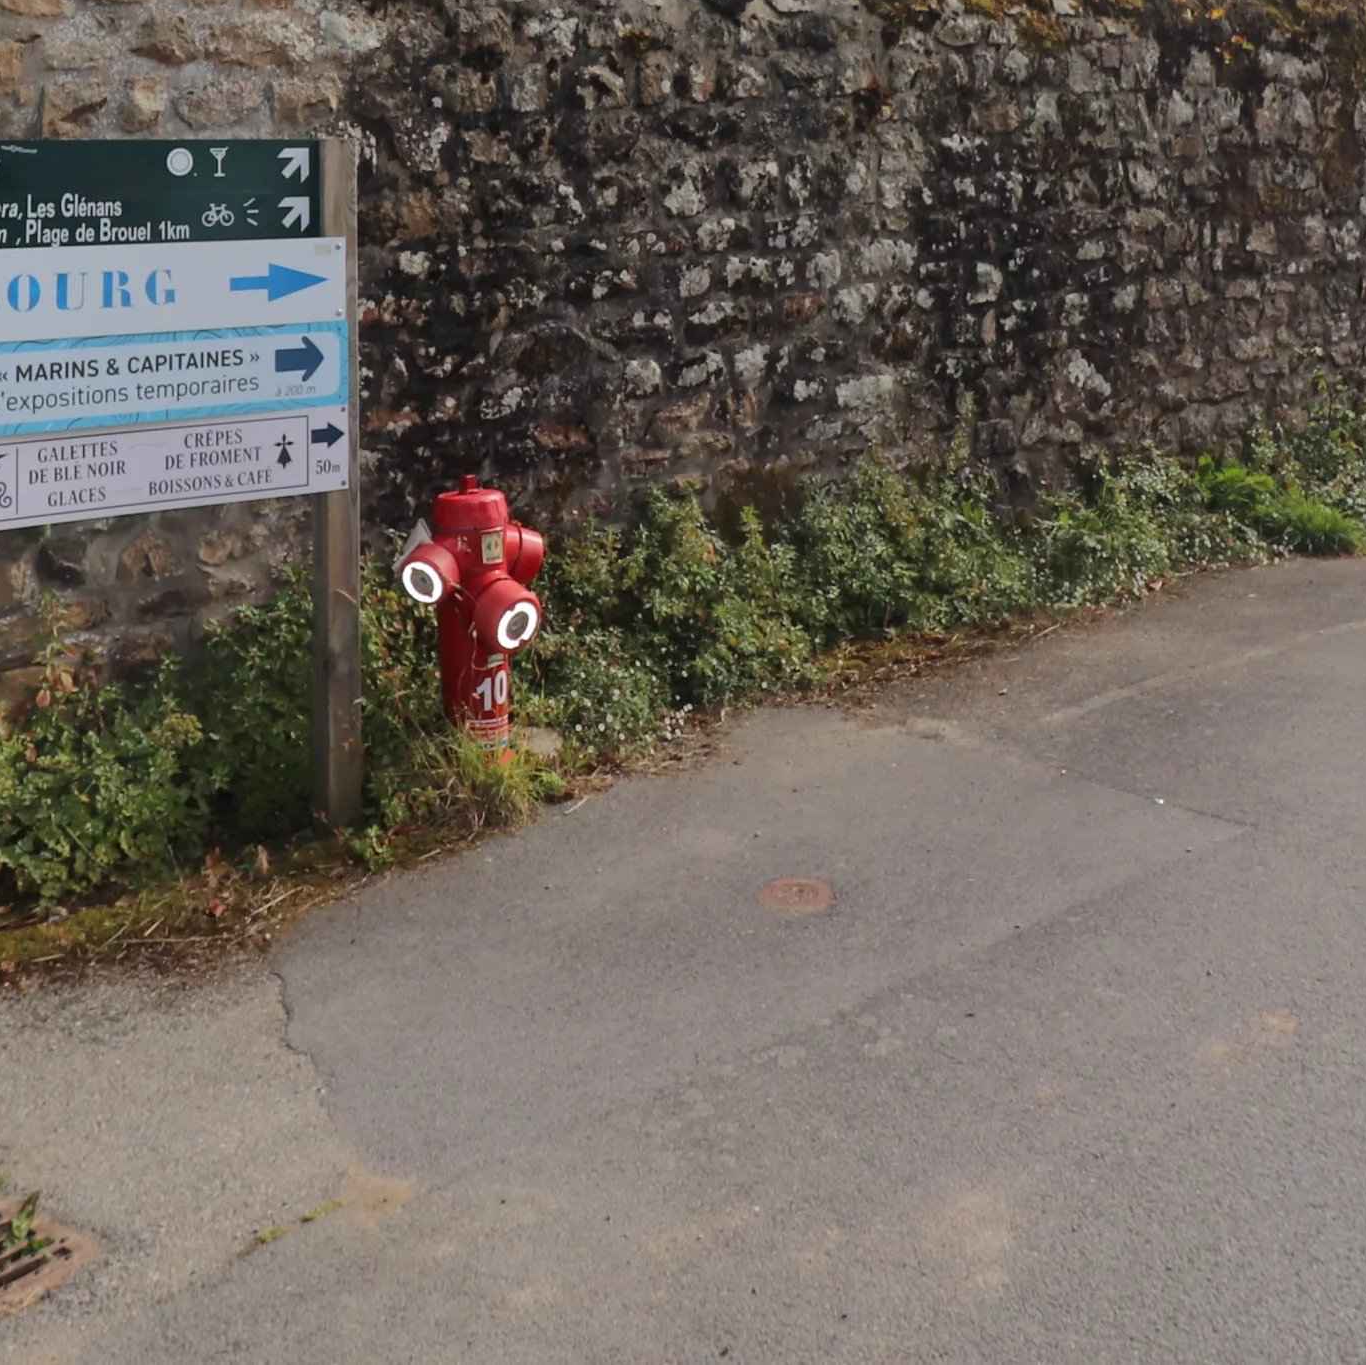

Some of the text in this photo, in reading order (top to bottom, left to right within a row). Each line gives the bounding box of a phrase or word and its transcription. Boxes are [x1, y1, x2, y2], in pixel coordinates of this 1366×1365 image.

[27, 194, 55, 218] Les
[61, 192, 122, 217] Glénans
[75, 222, 95, 242] de
[100, 218, 151, 242] Brouel
[158, 221, 190, 240] 1km
[16, 359, 99, 383] MARINS
[106, 358, 120, 376] &
[127, 349, 244, 374] CAPITAINES
[136, 374, 259, 402] temporaires
[37, 440, 118, 463] GALETTES
[165, 446, 262, 470] DE FROMENT
[29, 468, 48, 485] DE
[87, 460, 126, 478] NOIR
[315, 460, 341, 475] 50m
[47, 486, 107, 507] GLACES
[148, 474, 221, 496] BOISSONS
[224, 474, 234, 487] &
[476, 670, 507, 711] 10
